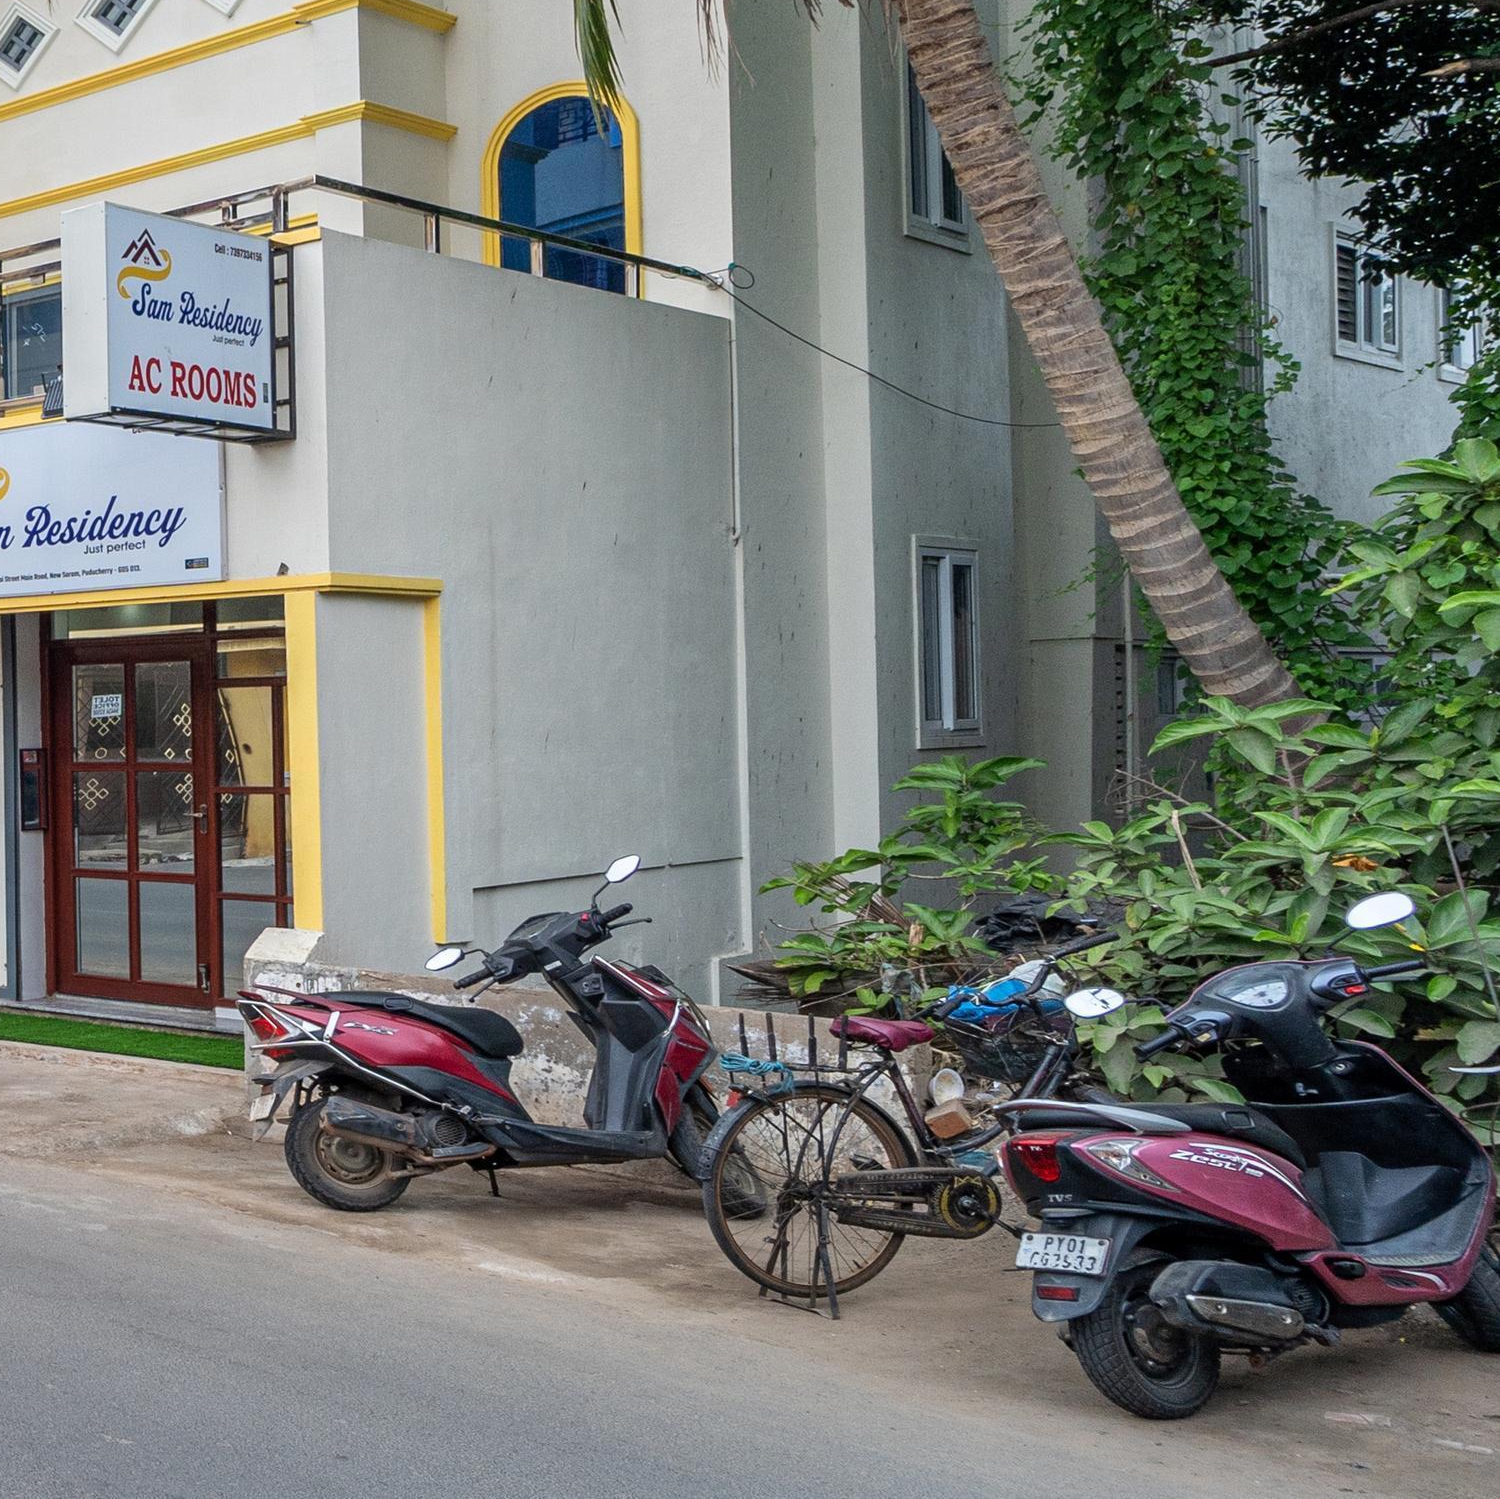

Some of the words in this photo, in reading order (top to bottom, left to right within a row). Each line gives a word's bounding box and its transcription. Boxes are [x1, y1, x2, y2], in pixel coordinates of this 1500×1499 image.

[132, 282, 175, 322] Sam
[178, 291, 263, 347] Residency
[212, 334, 223, 344] Just
[224, 335, 245, 347] perfect
[128, 355, 162, 395] AC
[170, 361, 257, 409] ROOMS
[21, 495, 187, 548] Residency
[84, 544, 104, 554] Just
[106, 540, 146, 554] perfect
[1047, 1194, 1073, 1203] TVS
[1043, 1236, 1087, 1254] PY01
